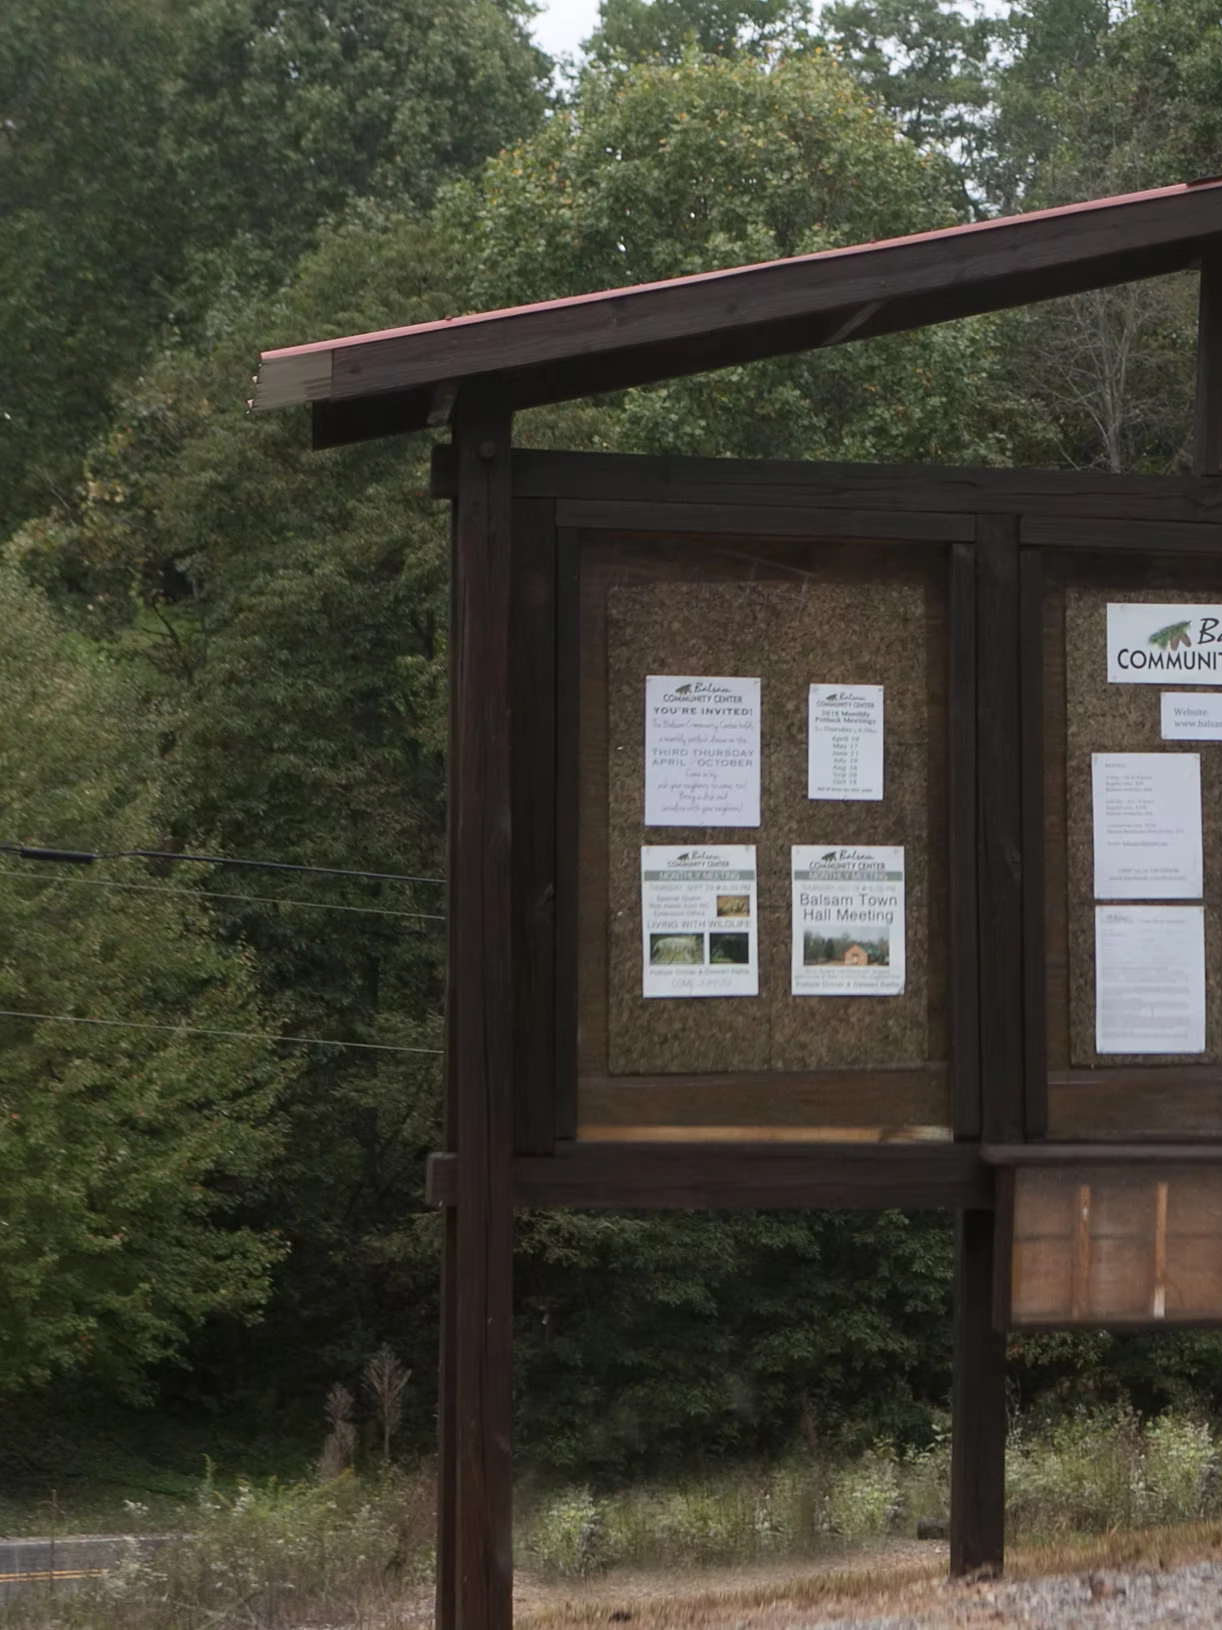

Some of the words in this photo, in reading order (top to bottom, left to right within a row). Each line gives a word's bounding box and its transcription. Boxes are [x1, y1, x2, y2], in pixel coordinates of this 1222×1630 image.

[694, 682, 731, 694] Balsam
[663, 694, 711, 703] COMMUNITY
[713, 695, 743, 704] CENTER
[653, 706, 698, 715] YOU'RE
[701, 706, 753, 716] INVITED!
[841, 710, 871, 719] Monthly
[652, 748, 689, 757] THIRD
[693, 748, 754, 758] THURSDAY
[652, 758, 687, 767] APRIL
[697, 758, 753, 768] OCTOBER
[809, 860, 856, 870] COMMUNITY
[799, 893, 854, 906] Balsam
[859, 893, 898, 906] Town
[803, 908, 832, 921] Hall
[836, 908, 894, 924] Meeting
[646, 920, 678, 929] LIVING
[681, 920, 706, 929] WITH
[708, 920, 751, 930] WILDLIFE
